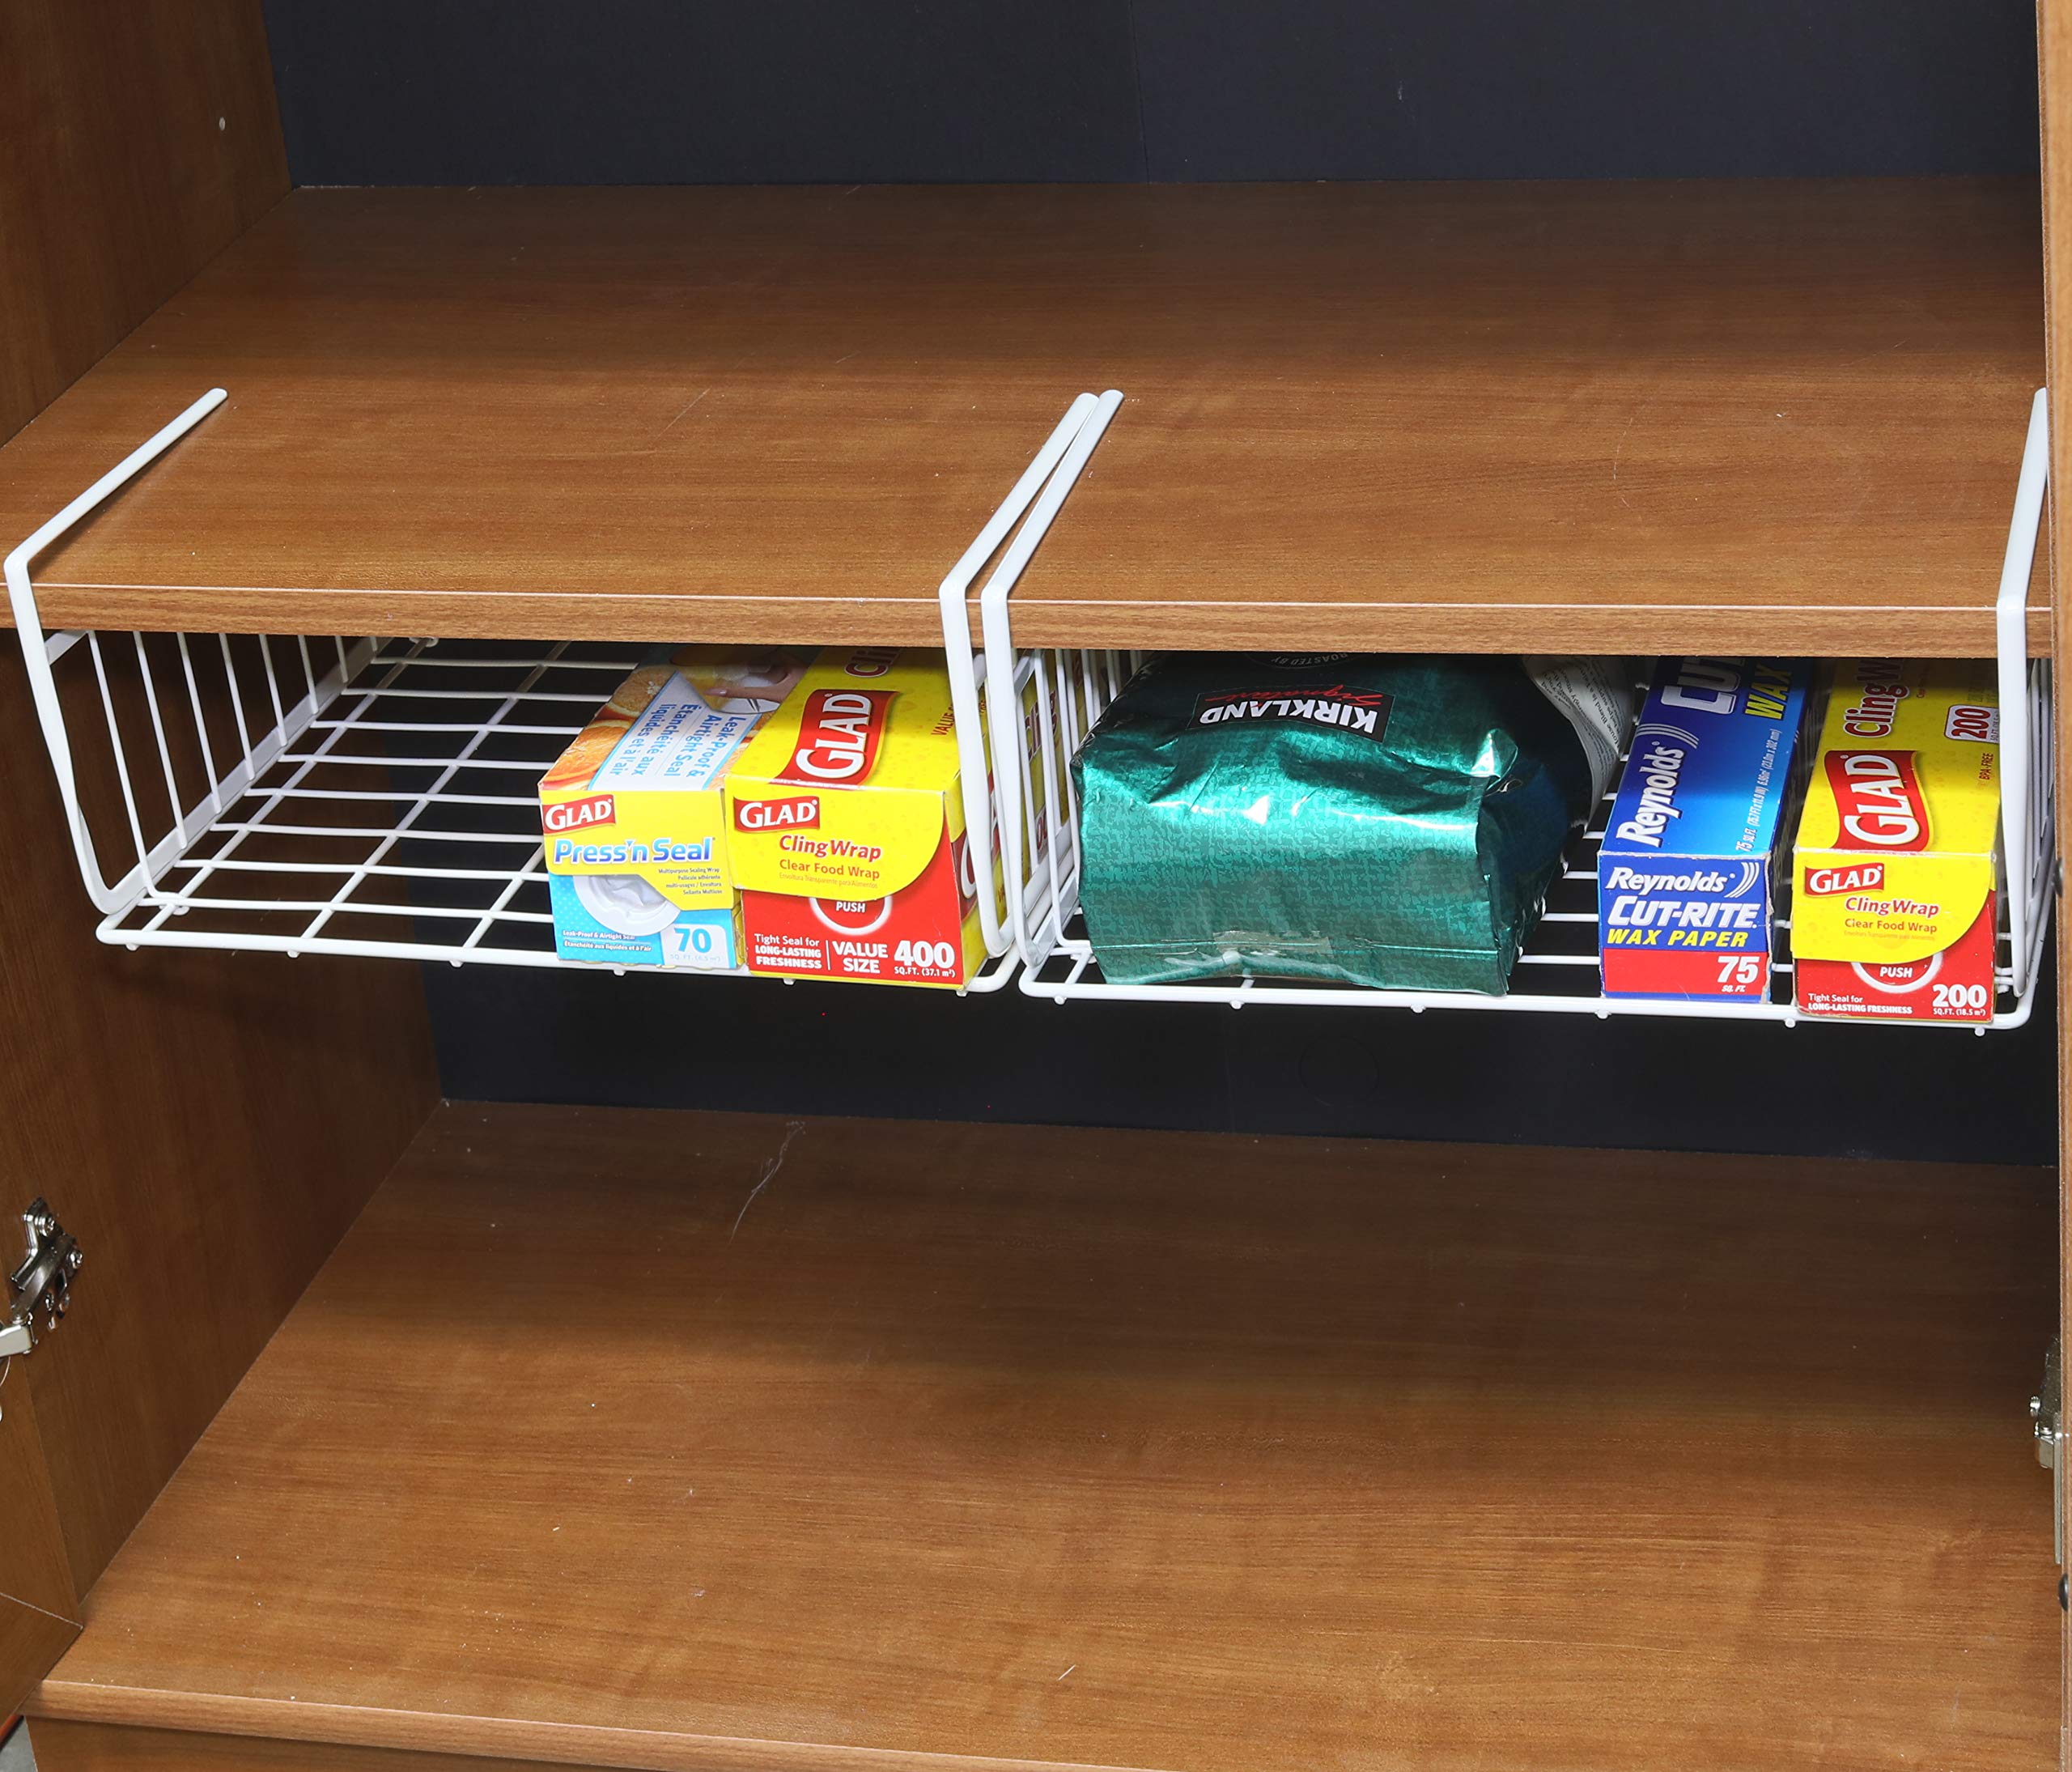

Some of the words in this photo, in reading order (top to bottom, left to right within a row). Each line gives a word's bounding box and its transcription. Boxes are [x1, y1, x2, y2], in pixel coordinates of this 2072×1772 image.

[1272, 656, 1289, 666] BY
[1205, 685, 1383, 708] Signature
[1745, 664, 1792, 720] WAX
[638, 703, 676, 737] liquides
[1199, 699, 1378, 733] KIRKLAND
[1951, 708, 1991, 740] 200
[631, 737, 646, 750] et
[681, 715, 721, 755] Airtight
[694, 716, 746, 768] Leak-Proof
[796, 694, 872, 779] GLAD
[631, 756, 654, 776] aux
[664, 753, 691, 776] Seal
[1978, 753, 1993, 780] BPA-FREE
[1616, 746, 1685, 848] Reynolds
[1844, 754, 1920, 845] GLAD
[546, 798, 612, 831] GLAD
[739, 801, 817, 829] GLAD
[554, 839, 648, 864] Press'n
[652, 837, 711, 863] Seal
[1734, 841, 1755, 852] 75
[779, 859, 811, 873] Clear
[813, 862, 844, 876] Food
[847, 866, 880, 881] Wrap
[1605, 867, 1728, 895] Reynolds
[1809, 868, 1882, 894] GLAD
[836, 901, 866, 913] PUSH
[1607, 895, 1760, 928] CUT-RITE
[1607, 928, 1662, 945] WAX
[1667, 930, 1748, 948] PAPER
[1845, 919, 1873, 929] Clear
[1877, 920, 1904, 931] Food
[1908, 922, 1938, 935] Wrap
[674, 928, 711, 954] 70
[754, 933, 779, 945] Tight
[782, 935, 803, 945] Seal
[805, 937, 820, 946] for
[832, 941, 888, 958] VALUE
[755, 945, 822, 958] LONG-LASTING
[756, 956, 822, 970] FRESHNESS
[894, 940, 955, 969] 400
[843, 958, 881, 974] SIZE
[921, 967, 941, 978] (37.1
[1717, 956, 1760, 984] 75
[1879, 967, 1913, 978] PUSH
[1808, 992, 1830, 1003] Tight
[1832, 994, 1849, 1002] Seal
[1850, 995, 1863, 1003] for
[1932, 984, 1987, 1008] 200
[1808, 1002, 1866, 1013] LONG-LASTING
[1867, 1005, 1913, 1014] FRESHNESS
[1955, 1008, 1974, 1017] (18.5
